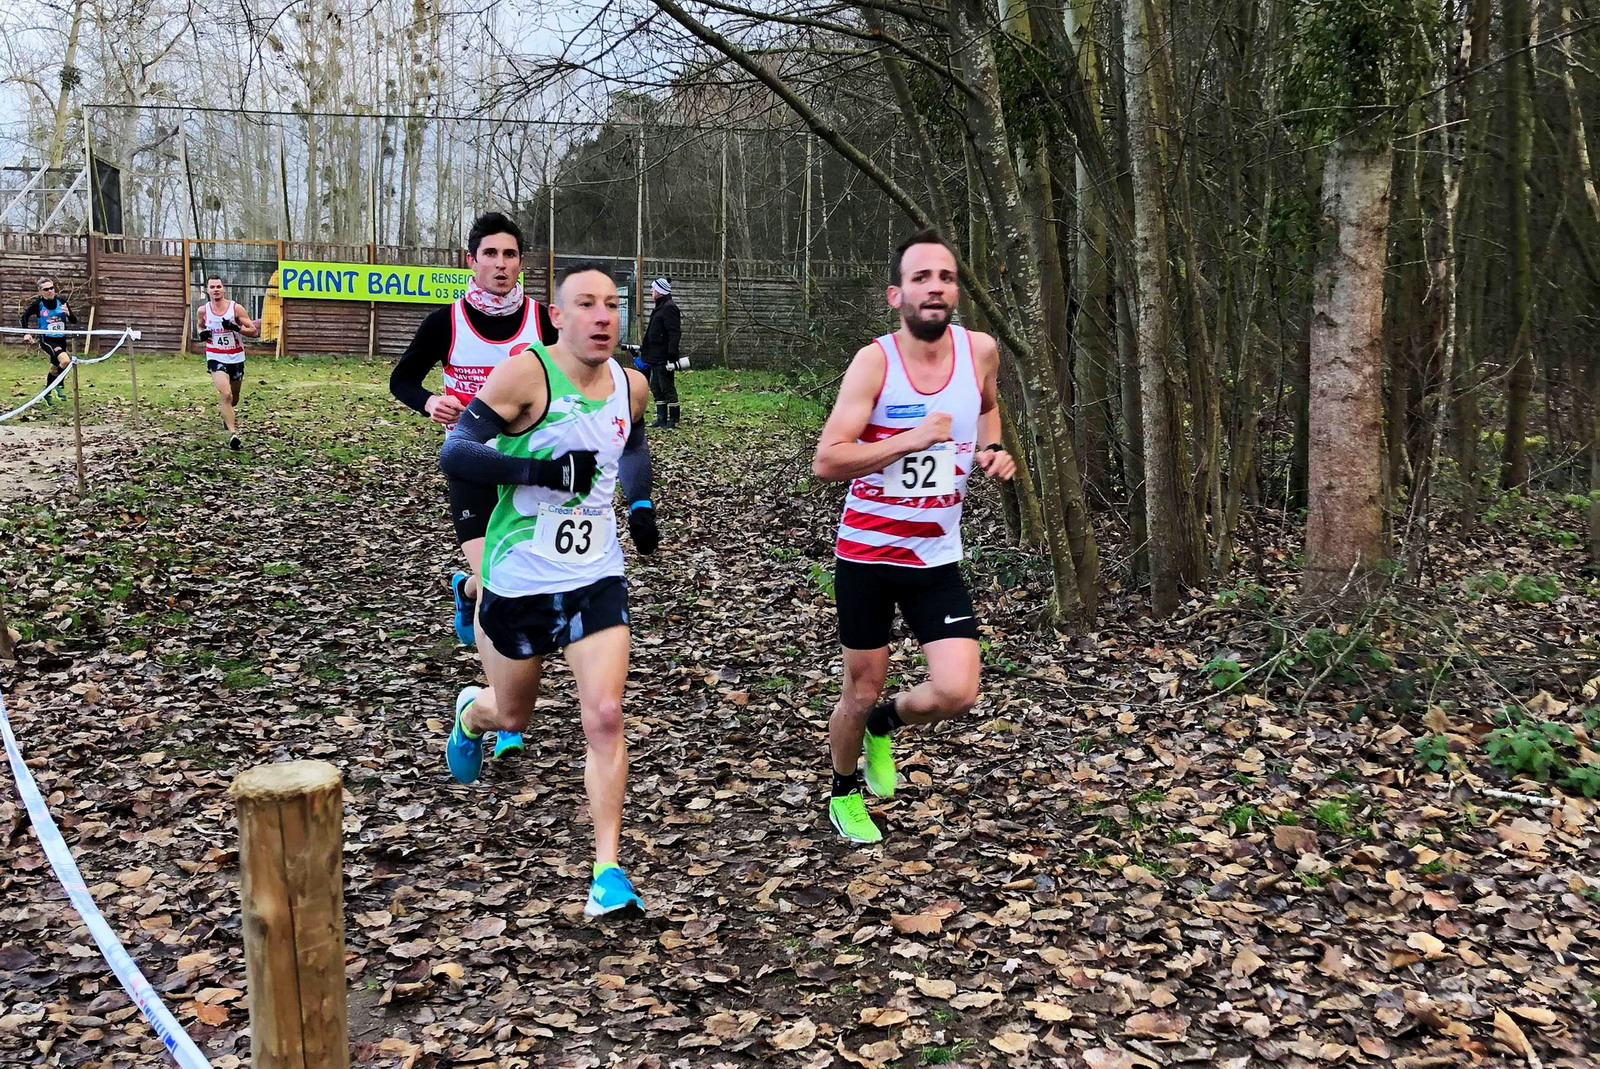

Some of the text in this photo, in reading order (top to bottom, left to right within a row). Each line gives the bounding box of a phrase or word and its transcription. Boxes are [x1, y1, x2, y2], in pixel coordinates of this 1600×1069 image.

[282, 268, 431, 296] PAINT BALL
[435, 288, 466, 300] 03 88
[217, 336, 230, 346] 45
[901, 455, 937, 490] 52
[554, 518, 593, 555] 63
